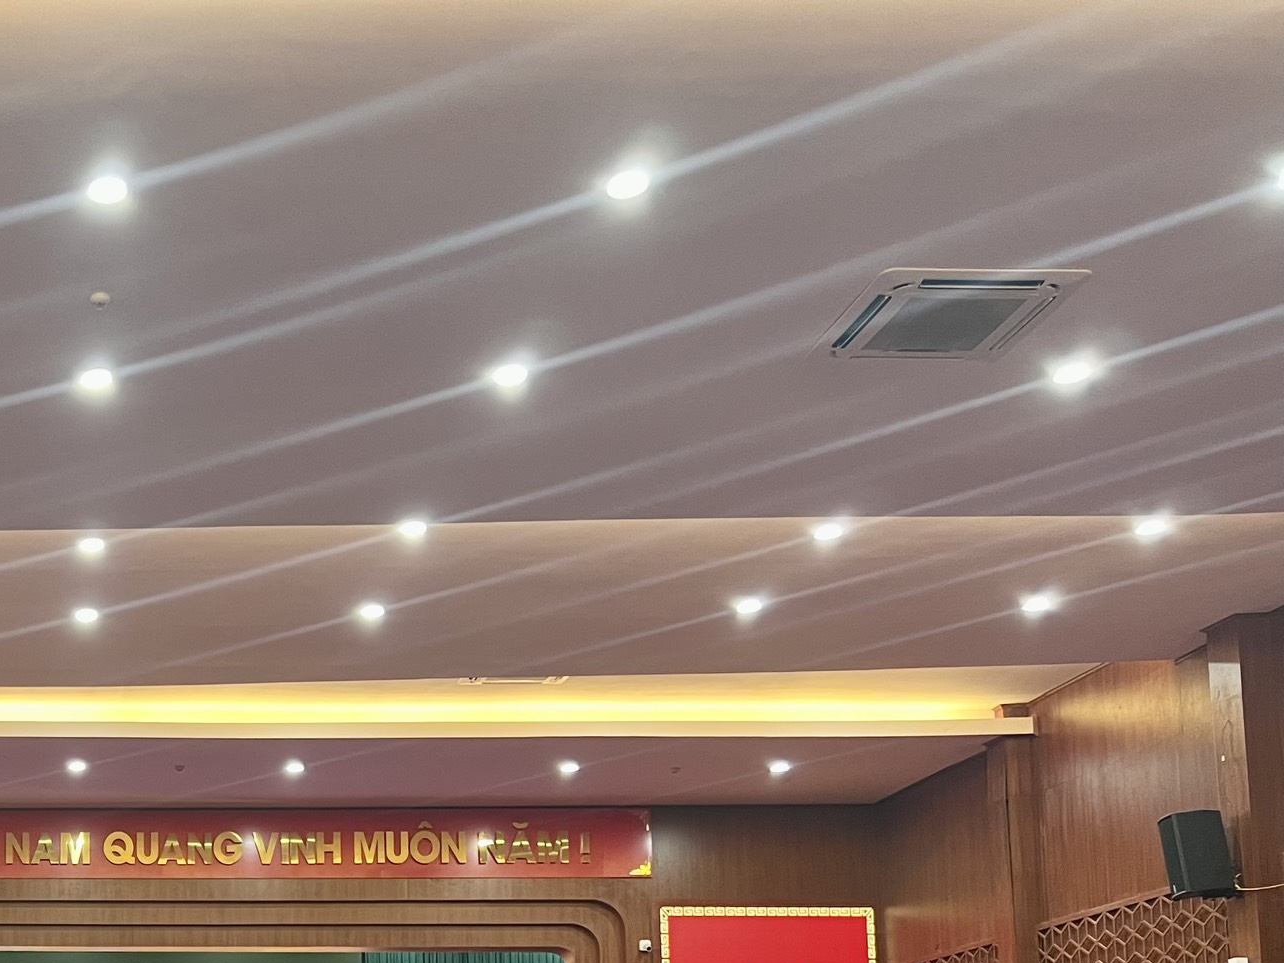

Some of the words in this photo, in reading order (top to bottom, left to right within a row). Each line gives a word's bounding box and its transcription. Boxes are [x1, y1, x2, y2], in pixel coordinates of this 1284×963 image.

[5, 831, 91, 865] NAM
[103, 831, 243, 865] QUANG
[253, 831, 341, 864] VINH
[353, 821, 468, 864] MUÔN
[478, 822, 570, 864] NĂM
[579, 832, 591, 863] !
